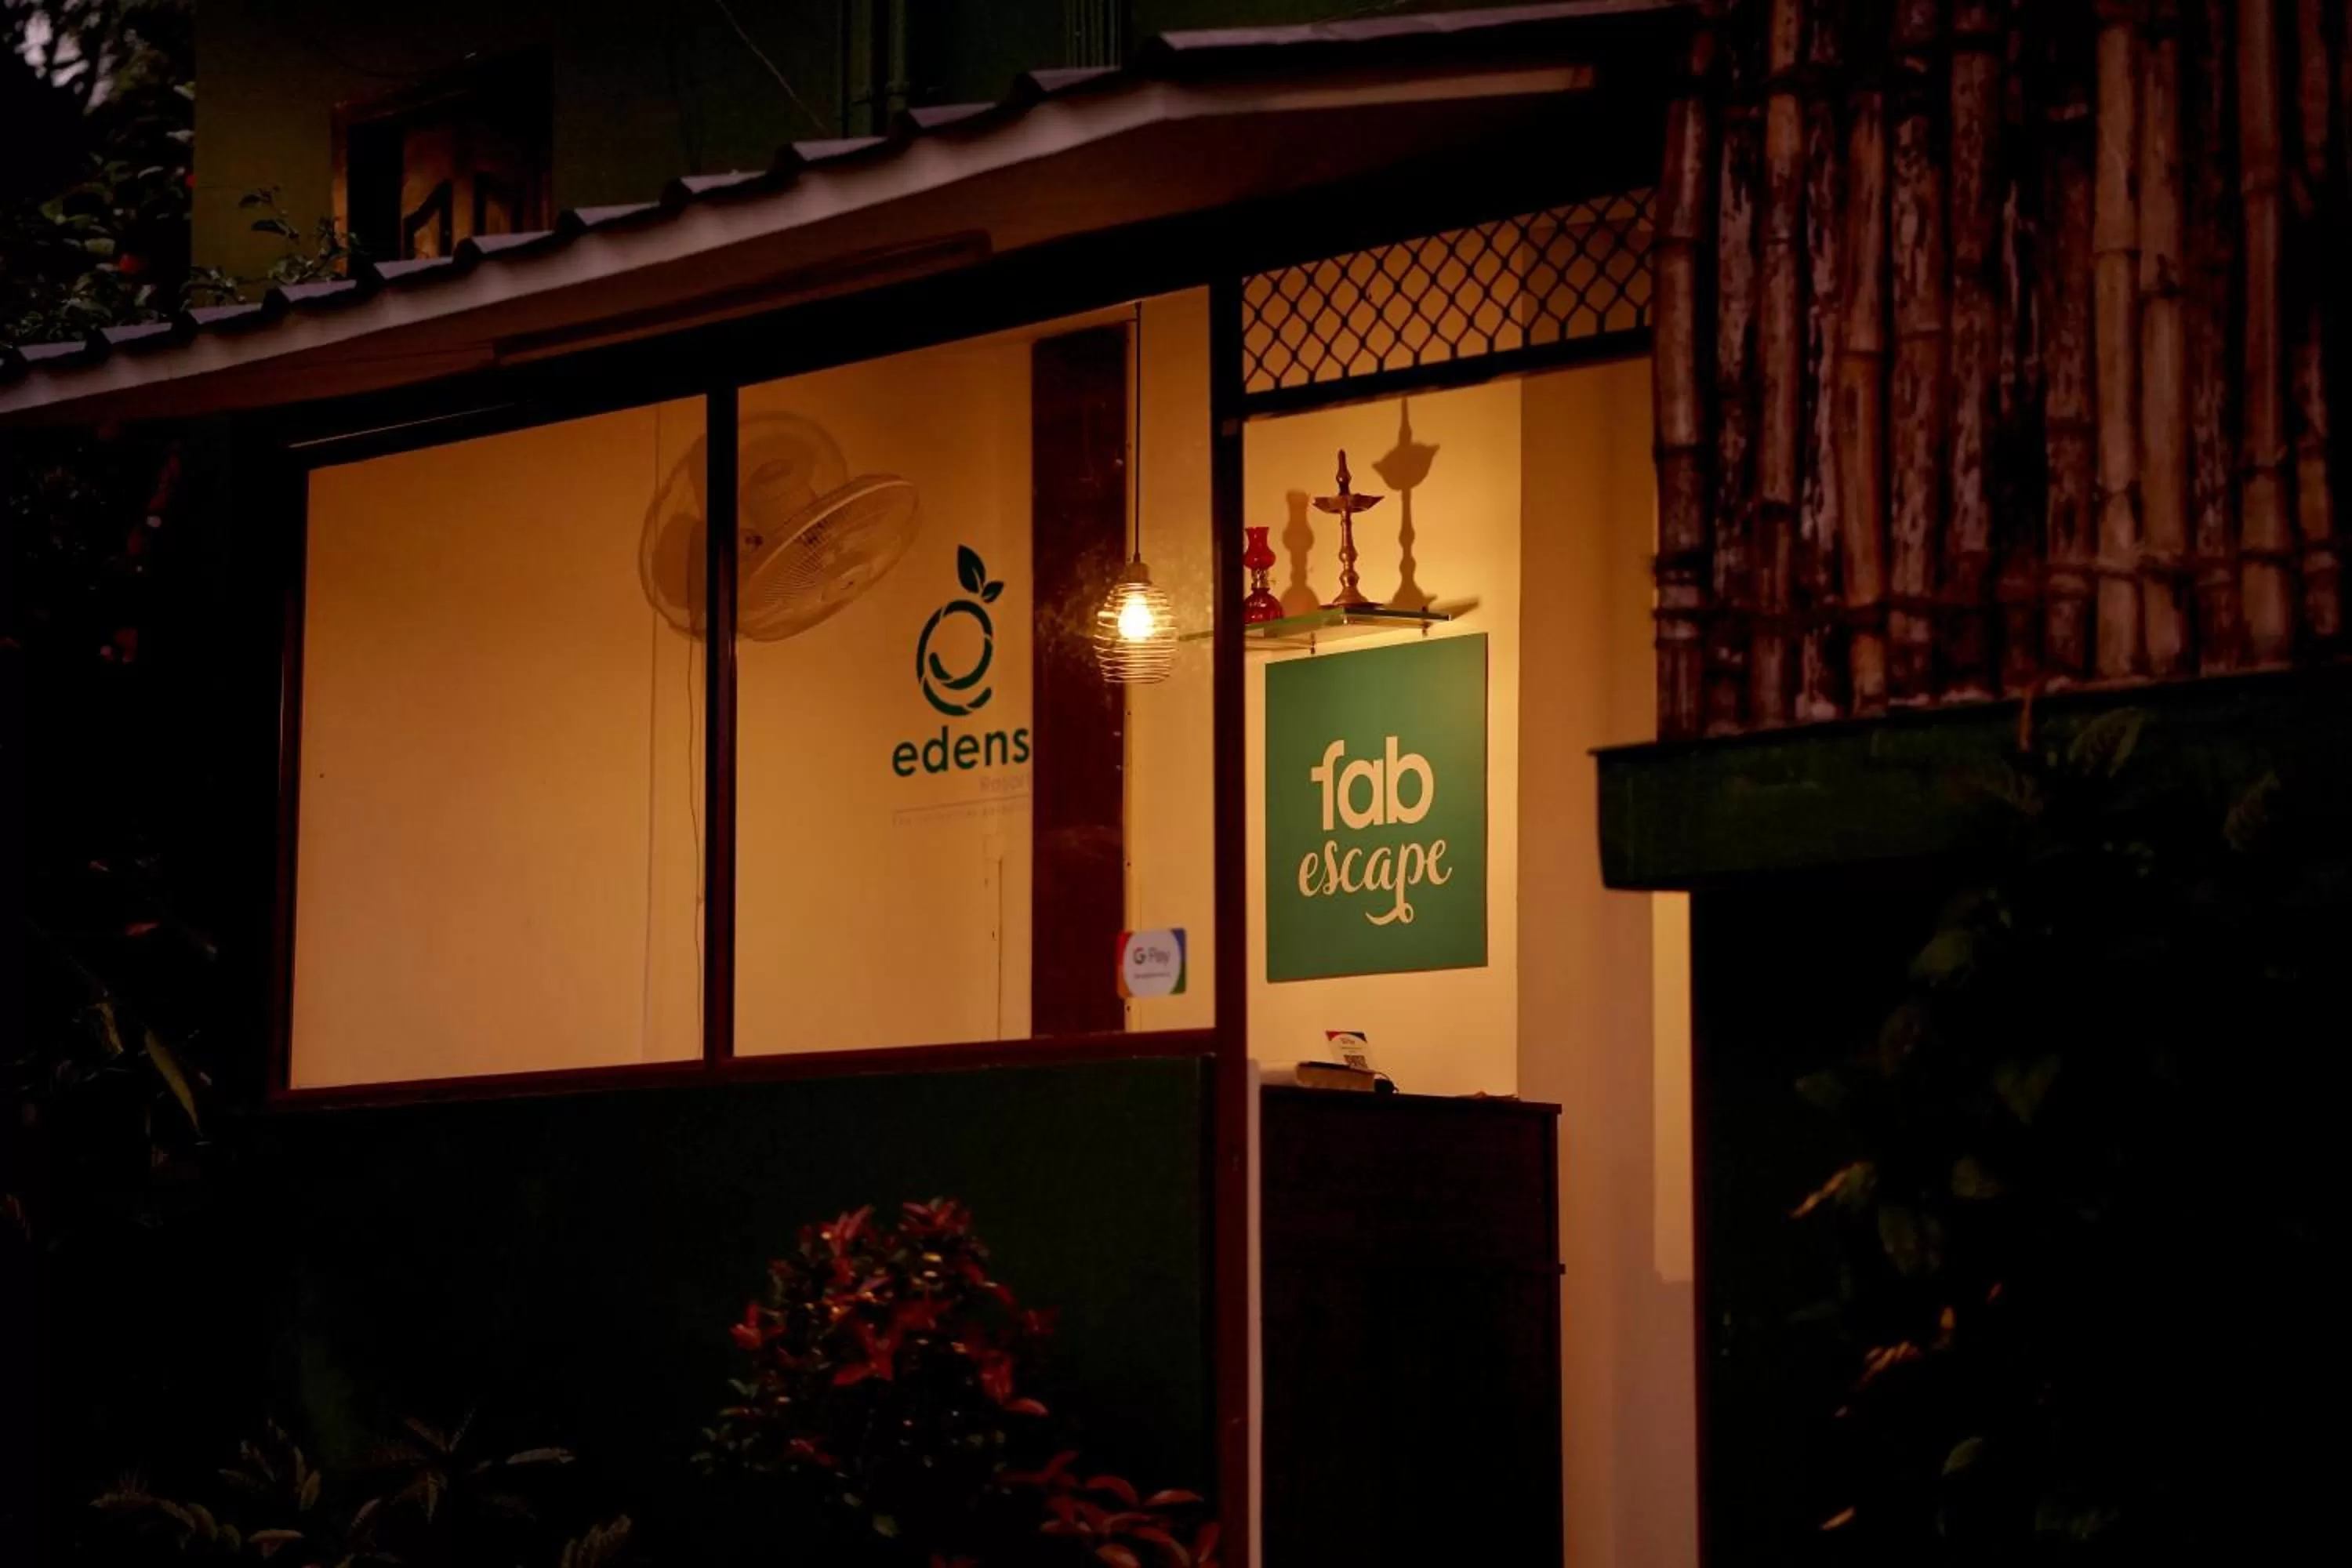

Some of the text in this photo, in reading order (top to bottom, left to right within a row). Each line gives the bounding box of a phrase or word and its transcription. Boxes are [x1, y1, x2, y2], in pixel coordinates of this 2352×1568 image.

[892, 725, 1029, 776] edens
[1311, 736, 1434, 830] fab
[1298, 840, 1452, 925] escape
